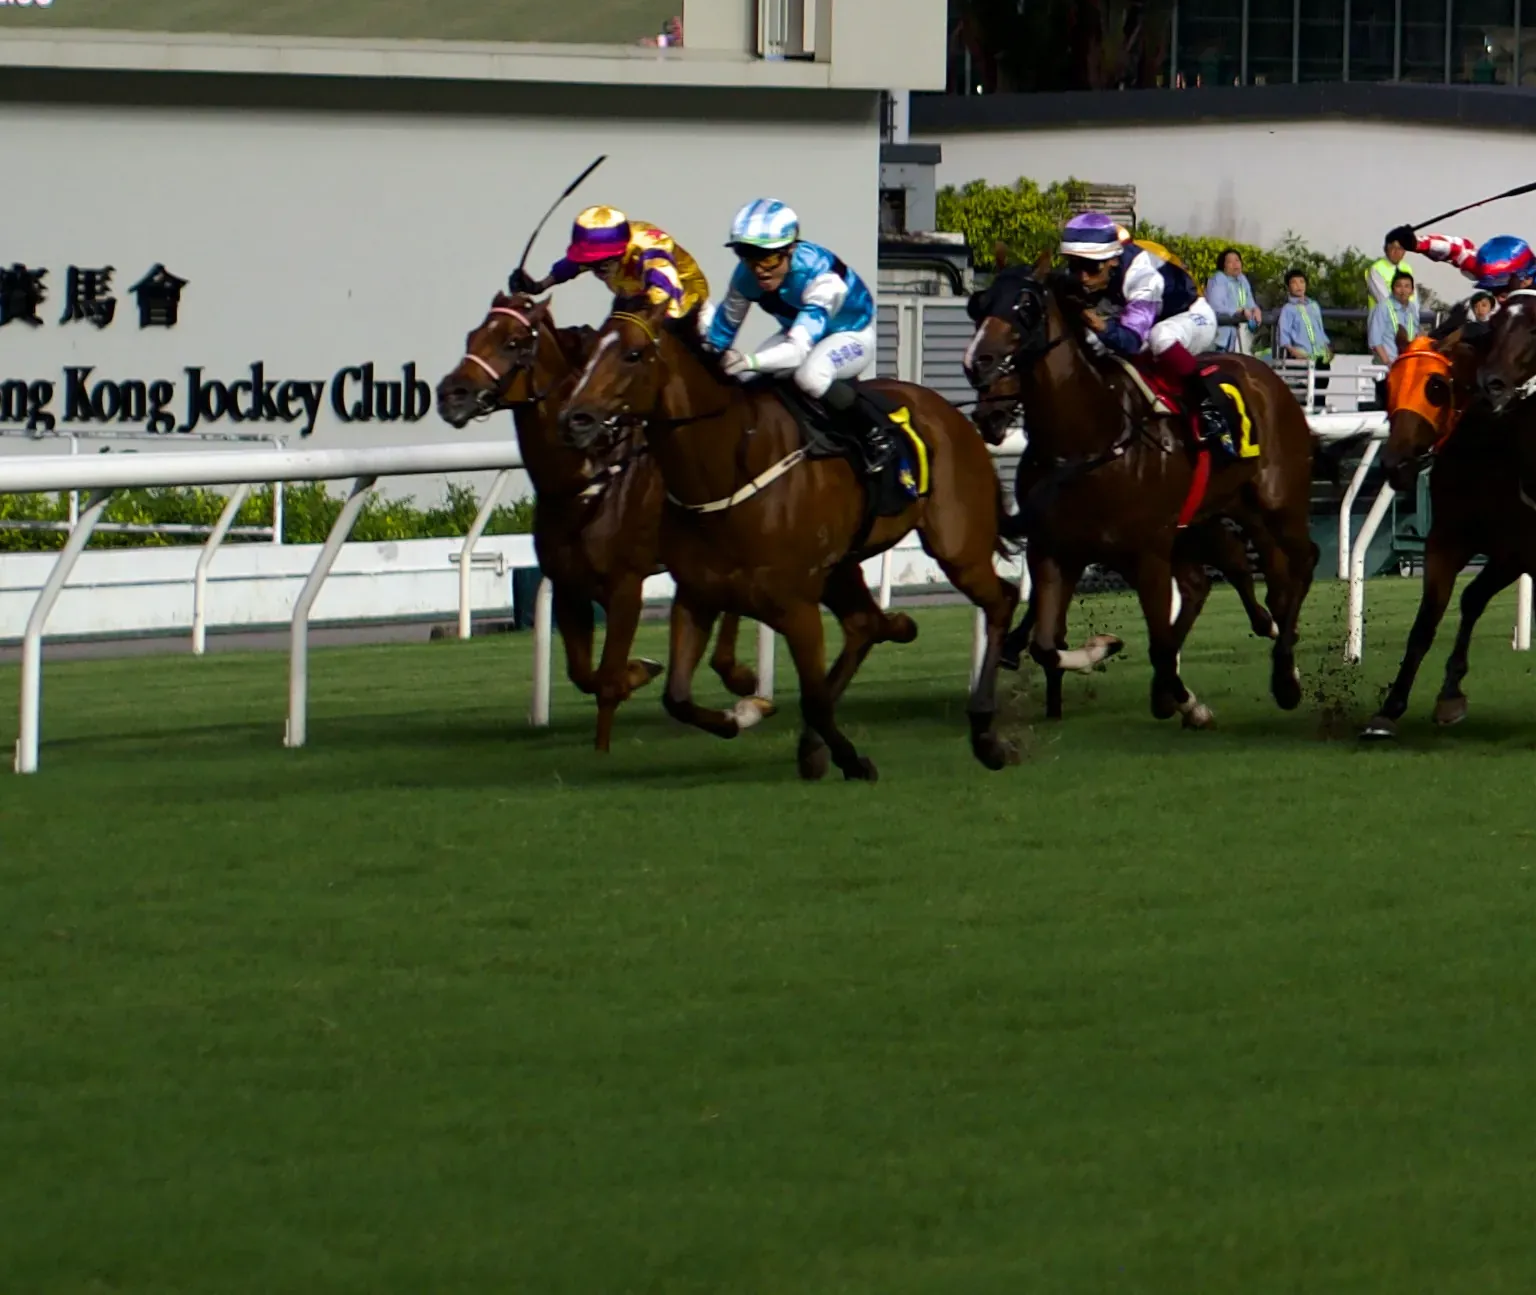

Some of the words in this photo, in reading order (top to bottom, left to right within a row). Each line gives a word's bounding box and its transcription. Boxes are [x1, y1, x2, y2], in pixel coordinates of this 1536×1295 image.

[0, 262, 190, 330] 賽馬會
[0, 378, 56, 439] ng
[62, 365, 176, 434] Kong
[178, 360, 327, 439] Jockey
[331, 361, 432, 423] Club
